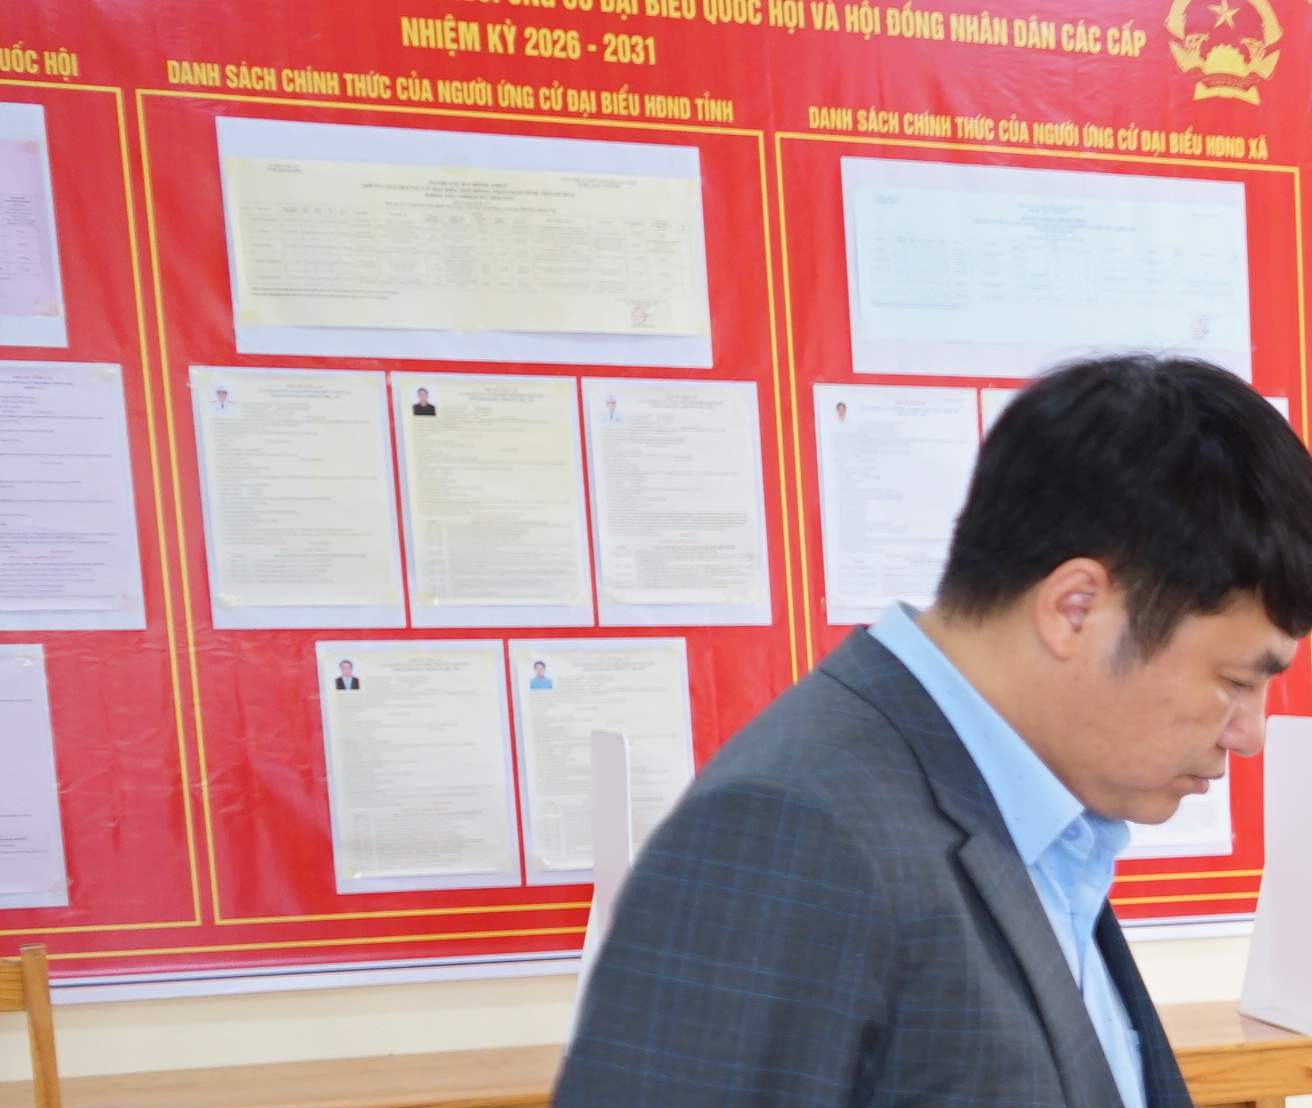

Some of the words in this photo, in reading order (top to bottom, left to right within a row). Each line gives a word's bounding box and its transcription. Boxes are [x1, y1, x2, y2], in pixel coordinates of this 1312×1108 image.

[400, 14, 482, 57] NHIỆM
[486, 17, 517, 55] KỲ
[523, 26, 582, 60] 2026
[602, 32, 656, 66] 2031
[769, 0, 805, 34] HỘI
[810, 0, 840, 32] VÀ
[844, 0, 881, 40] HỘI
[886, 0, 945, 41] ĐỒNG
[950, 10, 1008, 46] NHÂN
[1013, 14, 1056, 51] DÂN
[1061, 19, 1102, 54] CÁC
[1106, 19, 1147, 58] CẤP
[0, 41, 38, 74] UỐC
[43, 47, 79, 82] HỘI
[166, 59, 221, 88] DANH
[225, 60, 277, 92] SÁCH
[281, 65, 340, 96] CHÍNH
[343, 70, 392, 100] THỨC
[396, 70, 434, 103] CỦA
[437, 76, 493, 107] NGƯỜI
[497, 78, 535, 110] ỨNG
[539, 79, 565, 112] CỬ
[566, 88, 597, 118] ĐẠI
[601, 83, 641, 117] BIỂU
[644, 94, 692, 121] HĐND
[694, 91, 734, 123] TỈNH
[808, 105, 853, 132] DANH
[857, 104, 900, 135] SÁCH
[902, 109, 952, 139] CHÍNH
[954, 113, 996, 142] THỨC
[998, 113, 1030, 145] CỦA
[1032, 119, 1080, 148] NGƯỜI
[1082, 121, 1115, 150] ỨNG
[1116, 122, 1140, 152] CỬ
[1140, 129, 1166, 157] ĐẠI
[1169, 124, 1203, 156] BIỂU
[1205, 134, 1246, 159] HĐND
[1248, 135, 1269, 160] XÃ
